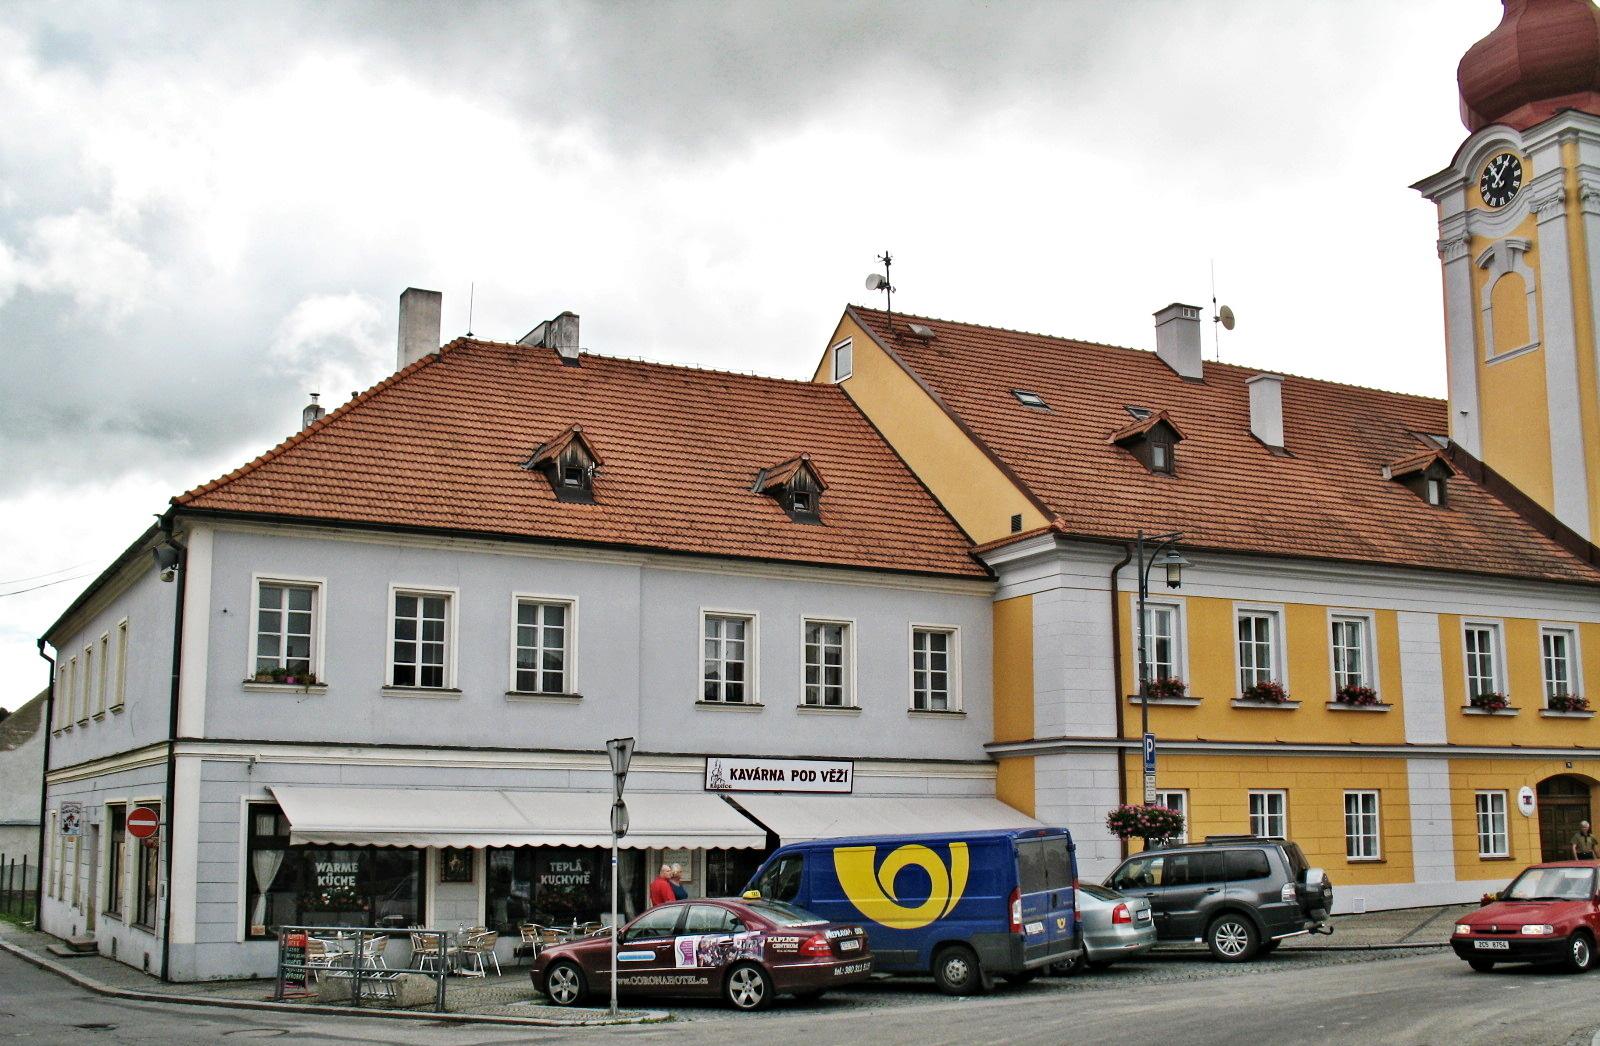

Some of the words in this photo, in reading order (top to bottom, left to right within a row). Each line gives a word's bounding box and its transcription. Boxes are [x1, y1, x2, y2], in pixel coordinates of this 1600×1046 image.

[1146, 738, 1153, 760] P
[730, 767, 785, 782] KAVÁRNA
[791, 769, 816, 782] POD
[821, 768, 848, 783] VĚŽÍ
[550, 859, 582, 871] TEPLÁ
[317, 872, 356, 886] KÜCHE
[540, 871, 590, 885] KUCHYNĚ
[613, 976, 708, 985] ww.CORONAHOTEL.cz
